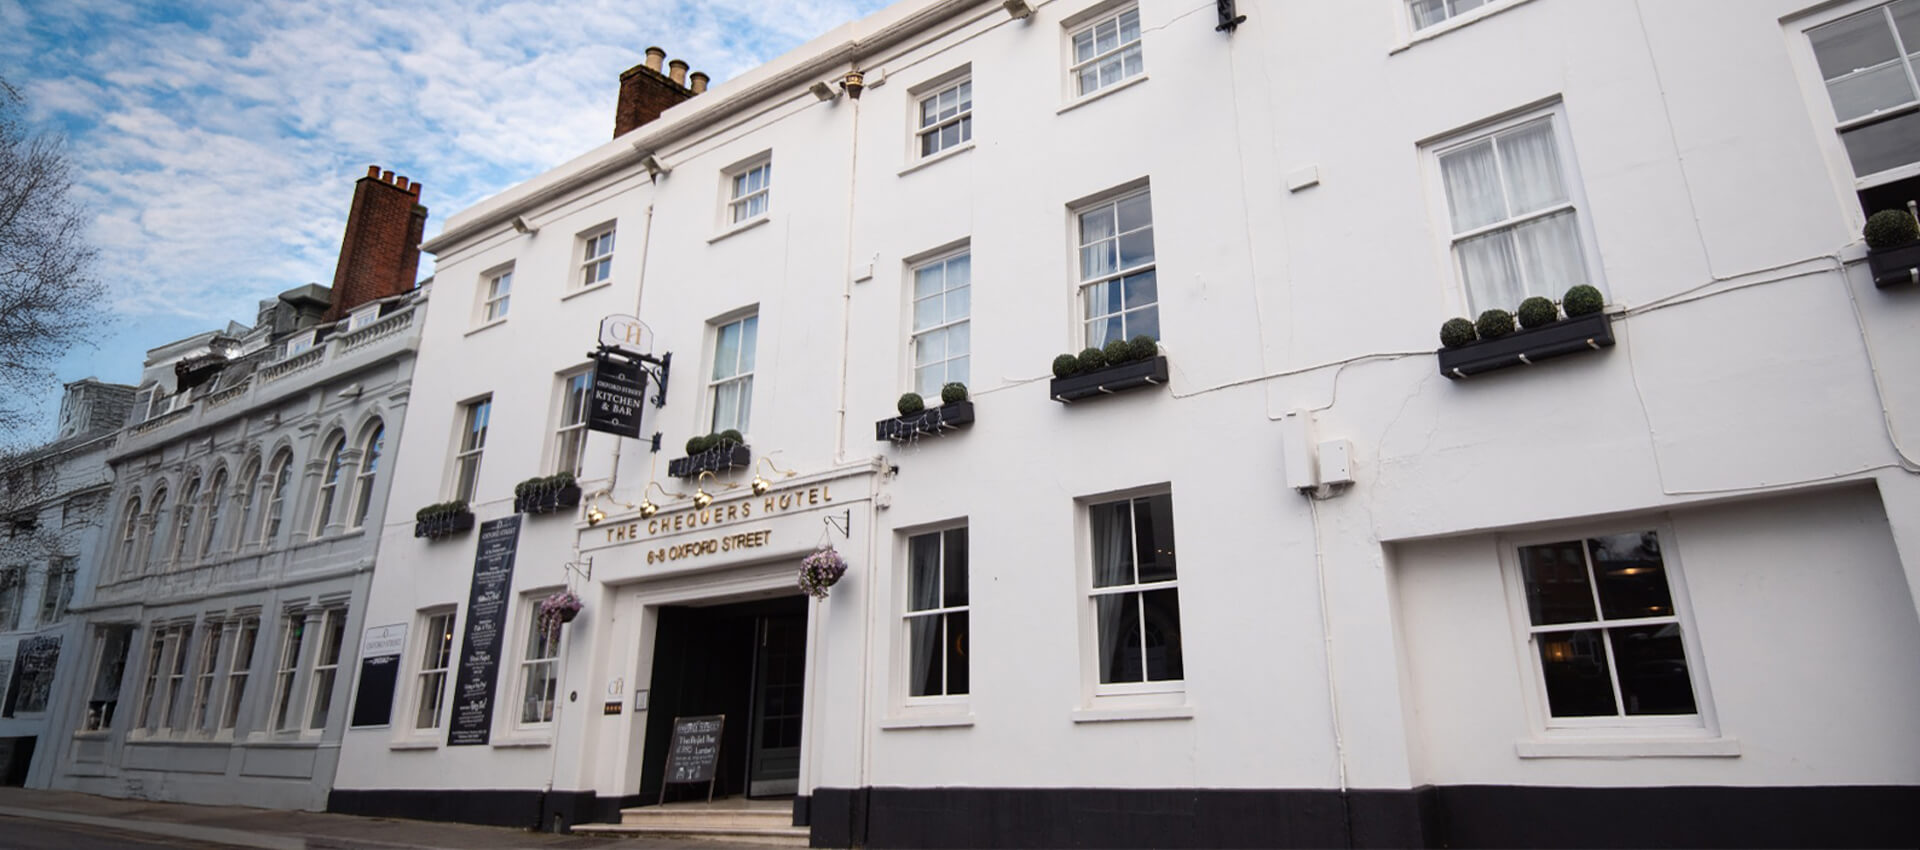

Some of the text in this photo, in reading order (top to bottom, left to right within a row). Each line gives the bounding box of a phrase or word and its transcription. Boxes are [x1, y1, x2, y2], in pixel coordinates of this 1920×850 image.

[597, 380, 642, 396] OXFORD STREET
[595, 390, 640, 408] KITCHEN
[601, 401, 633, 416] & BAR
[606, 486, 833, 542] THE CHEQUERS HOTEL
[647, 529, 772, 565] 6-8 OXFORD STREET
